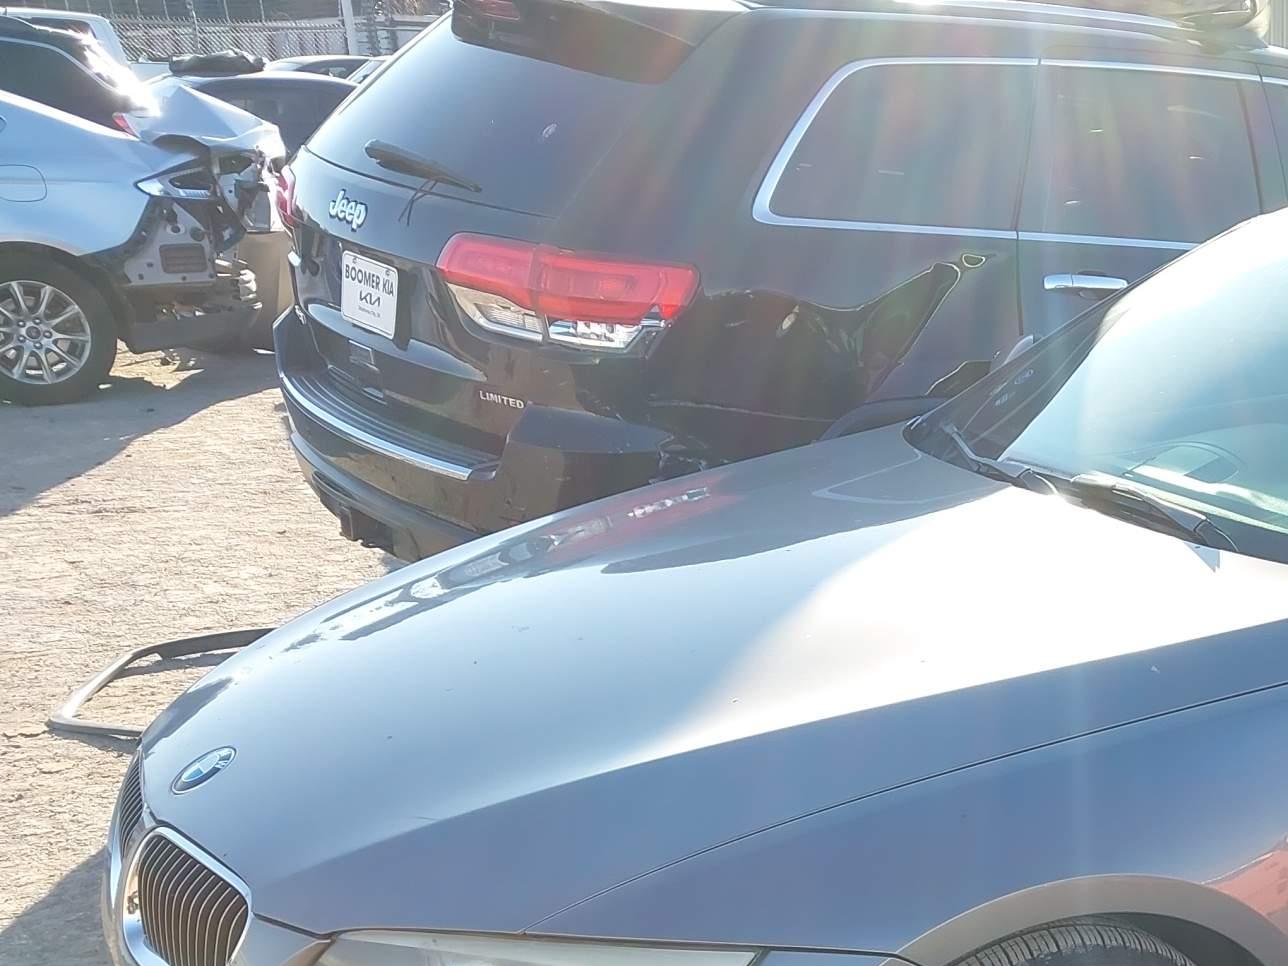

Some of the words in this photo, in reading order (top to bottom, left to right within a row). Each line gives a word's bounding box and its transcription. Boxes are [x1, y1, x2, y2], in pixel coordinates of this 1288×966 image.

[329, 188, 368, 231] Jeep
[344, 263, 381, 292] BOOMER
[382, 276, 395, 297] KIA
[479, 390, 525, 409] LIMITED
